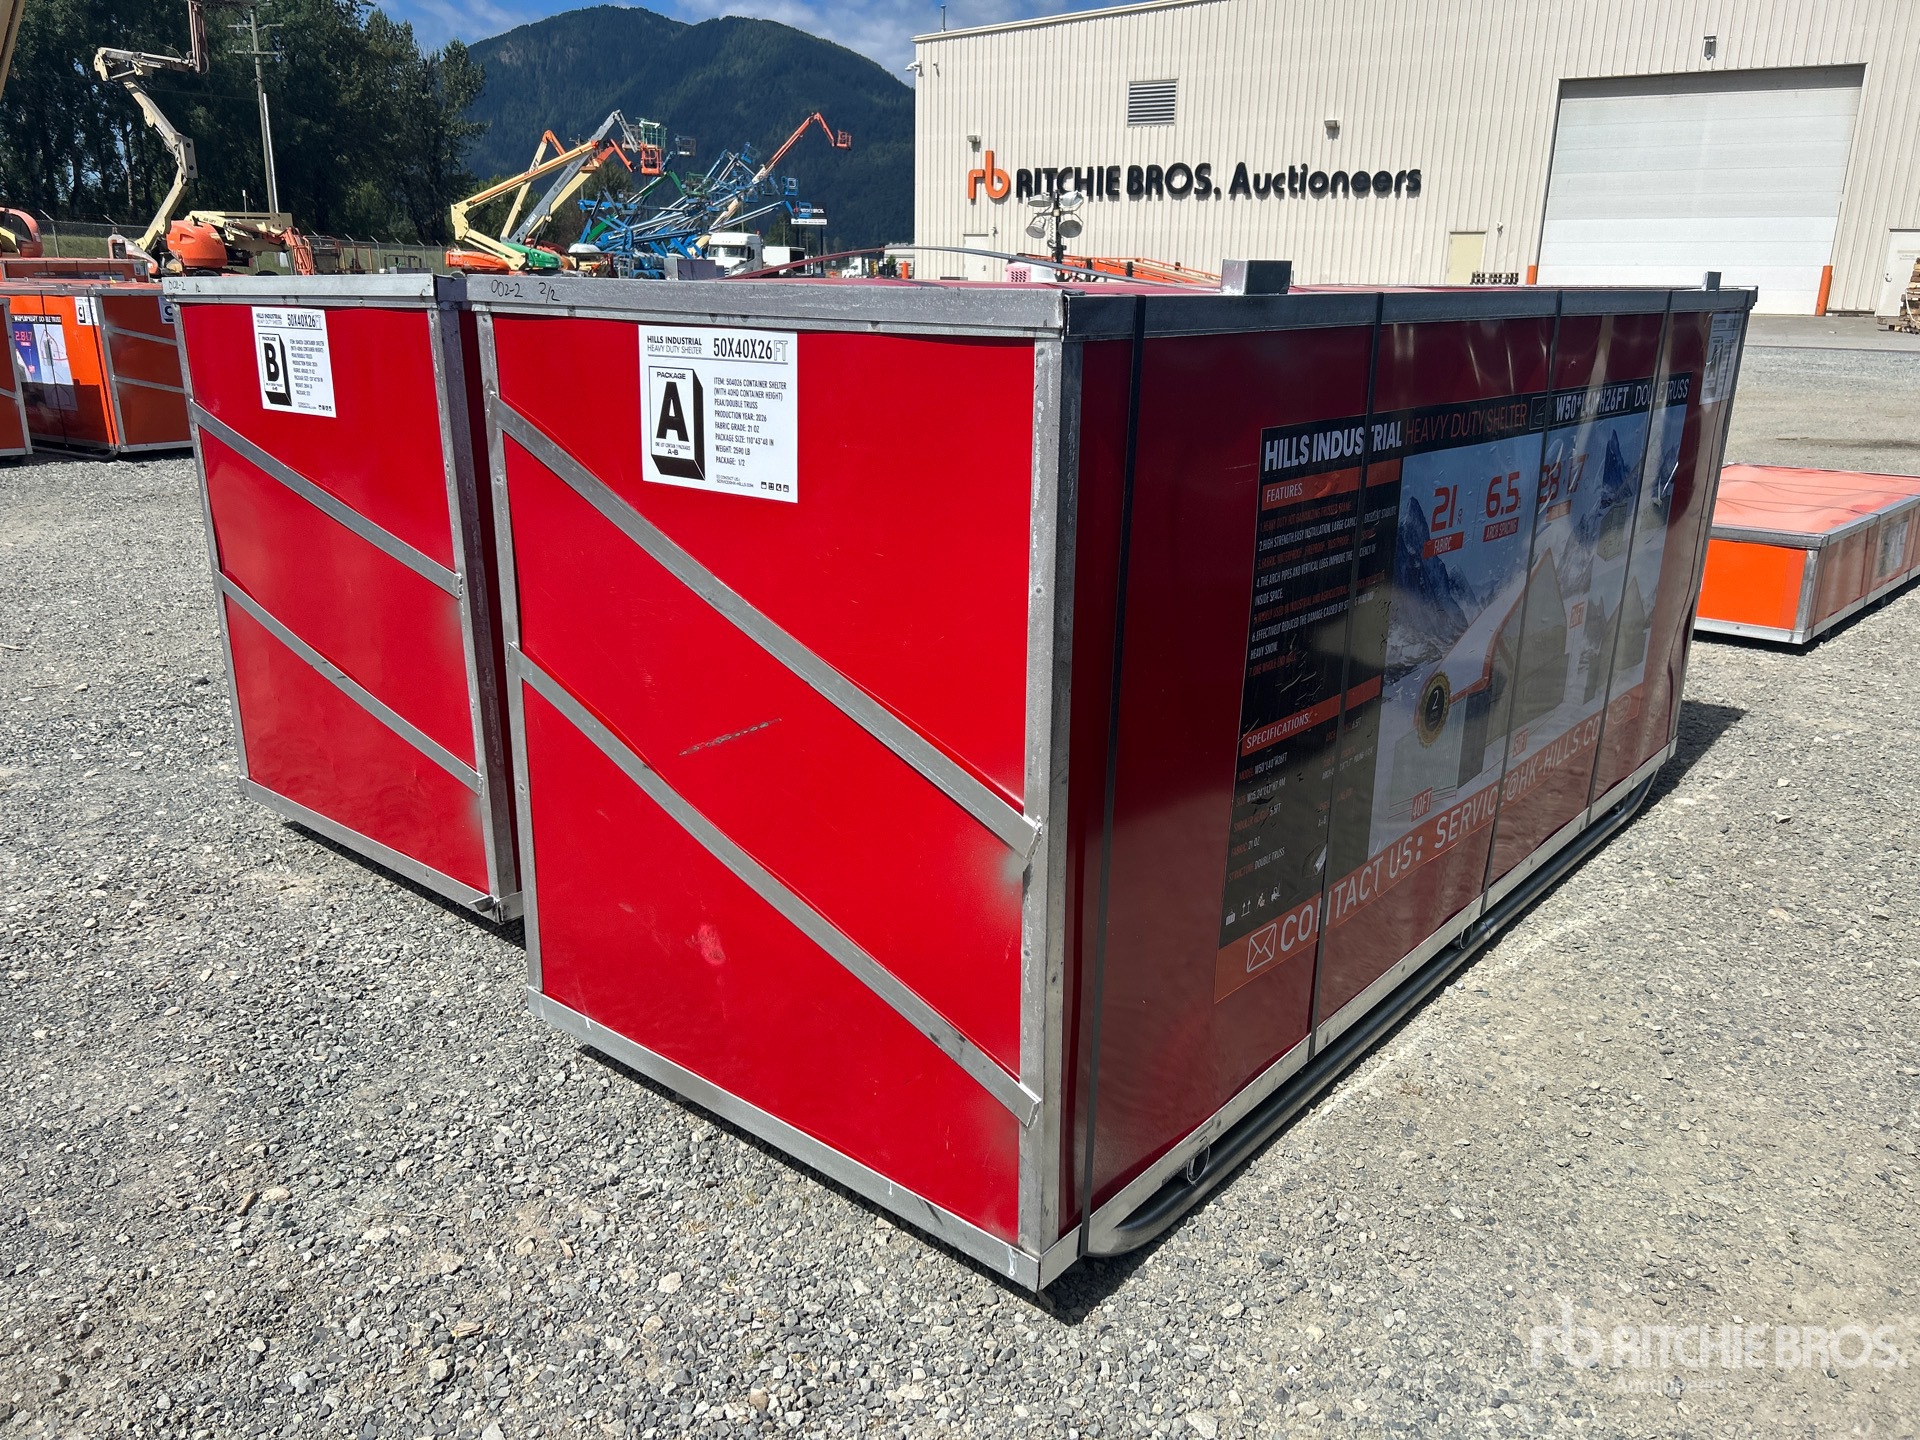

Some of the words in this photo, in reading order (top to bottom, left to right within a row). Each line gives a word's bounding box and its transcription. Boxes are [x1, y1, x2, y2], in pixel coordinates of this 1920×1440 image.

[1016, 165, 1121, 200] RITCHIE
[1229, 162, 1421, 199] Auctioneers
[491, 279, 523, 298] 002-2
[539, 282, 560, 303] 2/2
[647, 335, 663, 344] HILLS
[665, 336, 702, 346] INDUSTRIAL
[647, 344, 665, 352] HEAVY
[665, 345, 680, 353] DUTY
[681, 346, 702, 354] SHELTER
[264, 343, 280, 382] B
[656, 371, 686, 380] PACKAGE
[714, 377, 726, 385] ITEM:
[743, 379, 768, 388] CONTAINER
[769, 381, 787, 390] SHELTER
[714, 387, 727, 396] (WITH
[740, 389, 764, 399] CONTAINER
[765, 391, 783, 401] HEIGHT)
[656, 381, 689, 442] A
[744, 400, 758, 409] TRUSS
[714, 410, 741, 420] PRODUCTION
[742, 411, 755, 420] YEAR:
[714, 421, 730, 430] FABRIC
[731, 422, 747, 432] GRADE:
[1264, 434, 1309, 472] HILLS
[1312, 421, 1402, 463] INDUSRIAL
[1405, 414, 1449, 445] HEAVY
[1450, 410, 1485, 438] DUTY
[1486, 403, 1528, 433] SHELTER
[1664, 378, 1690, 402] TRUSS
[715, 433, 734, 443] PACKAGE
[769, 438, 774, 446] IN
[715, 444, 732, 454] WEIGHT:
[745, 447, 751, 456] LB
[715, 456, 737, 465] PACKAGE:
[1266, 482, 1303, 503] FEATURES
[1485, 471, 1520, 518] 6.5
[1431, 484, 1457, 532] 21
[1485, 523, 1499, 541] ARCH
[1499, 519, 1518, 538] SPACING
[1269, 572, 1280, 585] ARCH
[1301, 559, 1319, 575] VERTICAL
[1323, 603, 1338, 617] CAUSED
[1250, 646, 1264, 660] HEAVY
[1432, 689, 1439, 710] 2
[1412, 790, 1432, 819] 40FT
[1280, 856, 1383, 952] CONTACT
[1389, 836, 1423, 879] US:
[1434, 714, 1608, 849] SERVIC@HK-HILLS.CO
